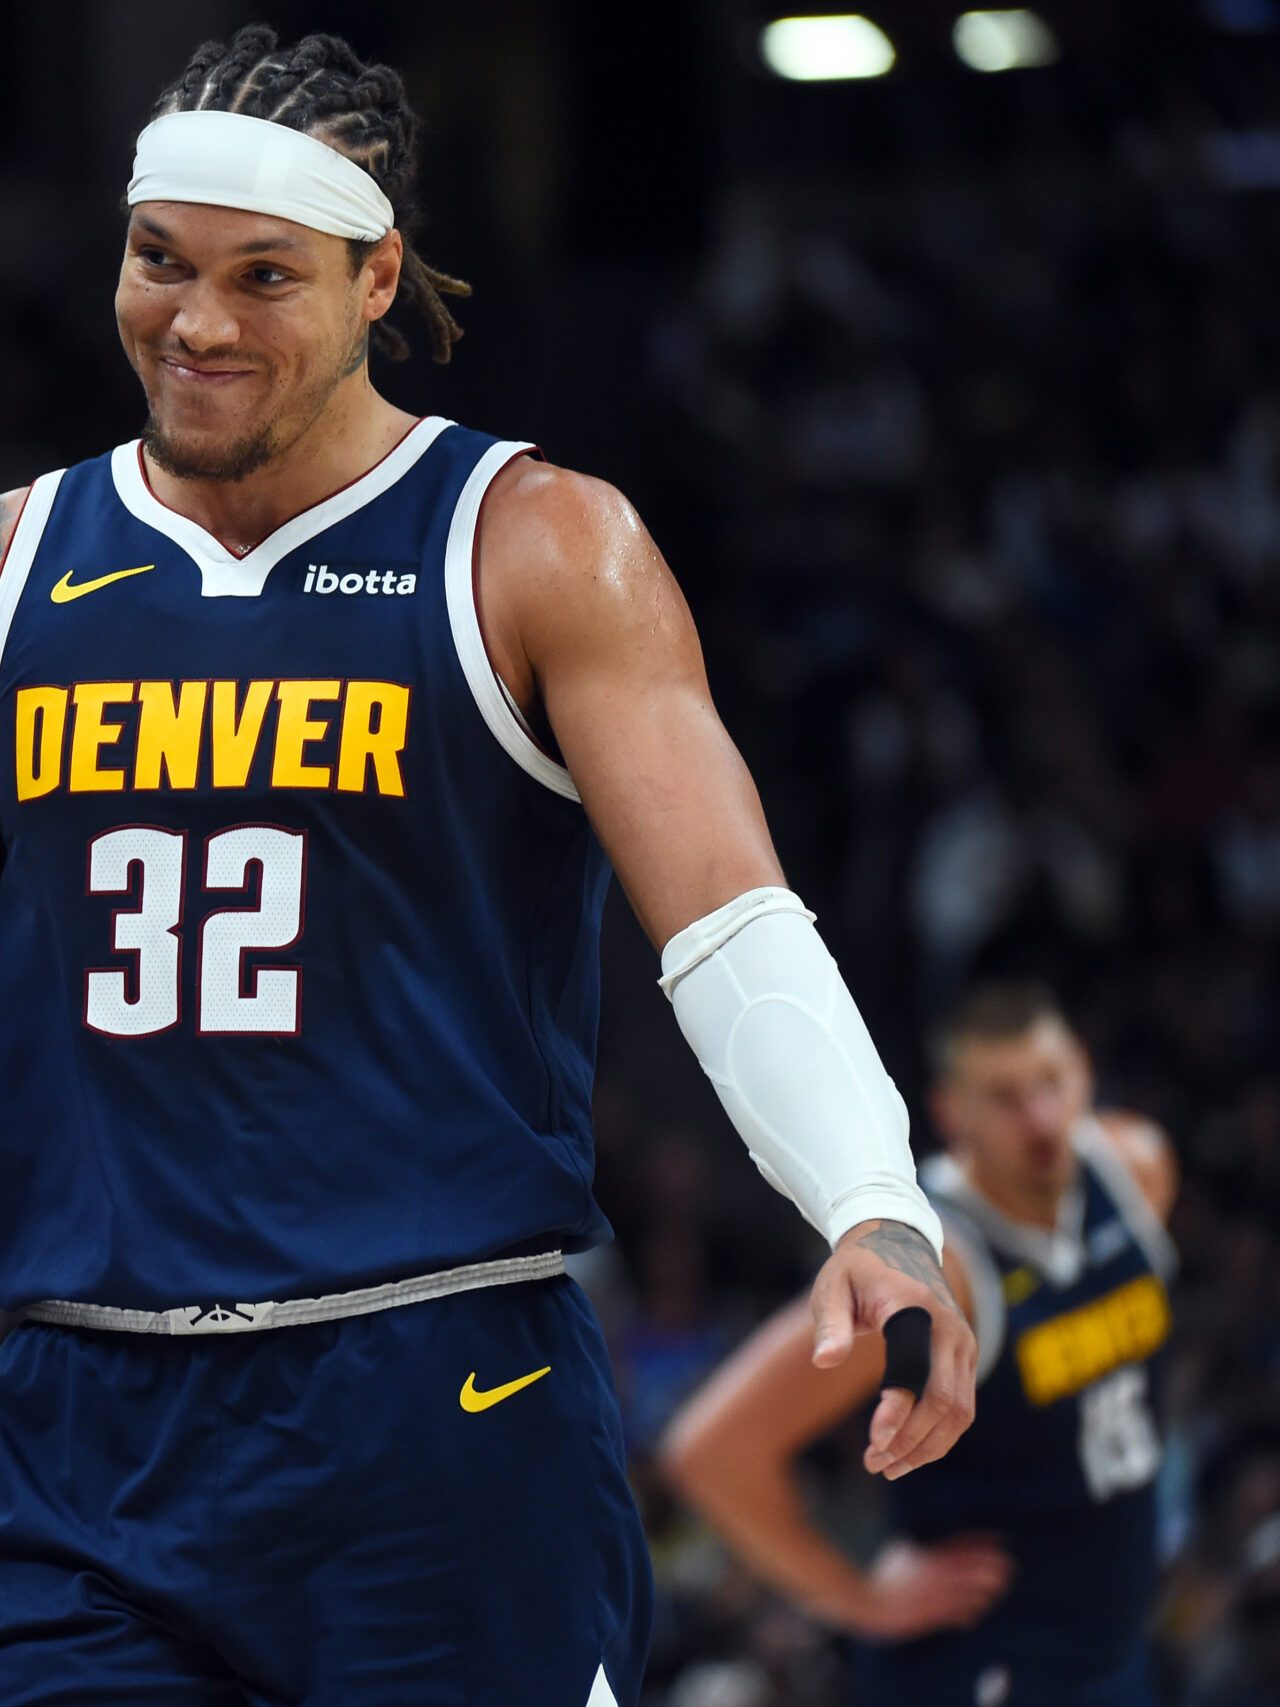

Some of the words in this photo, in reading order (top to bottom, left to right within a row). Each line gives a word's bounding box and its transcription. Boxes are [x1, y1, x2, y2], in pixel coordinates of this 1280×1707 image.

[303, 563, 417, 595] ibotta
[15, 678, 412, 803] DENVER
[82, 821, 308, 1039] 32
